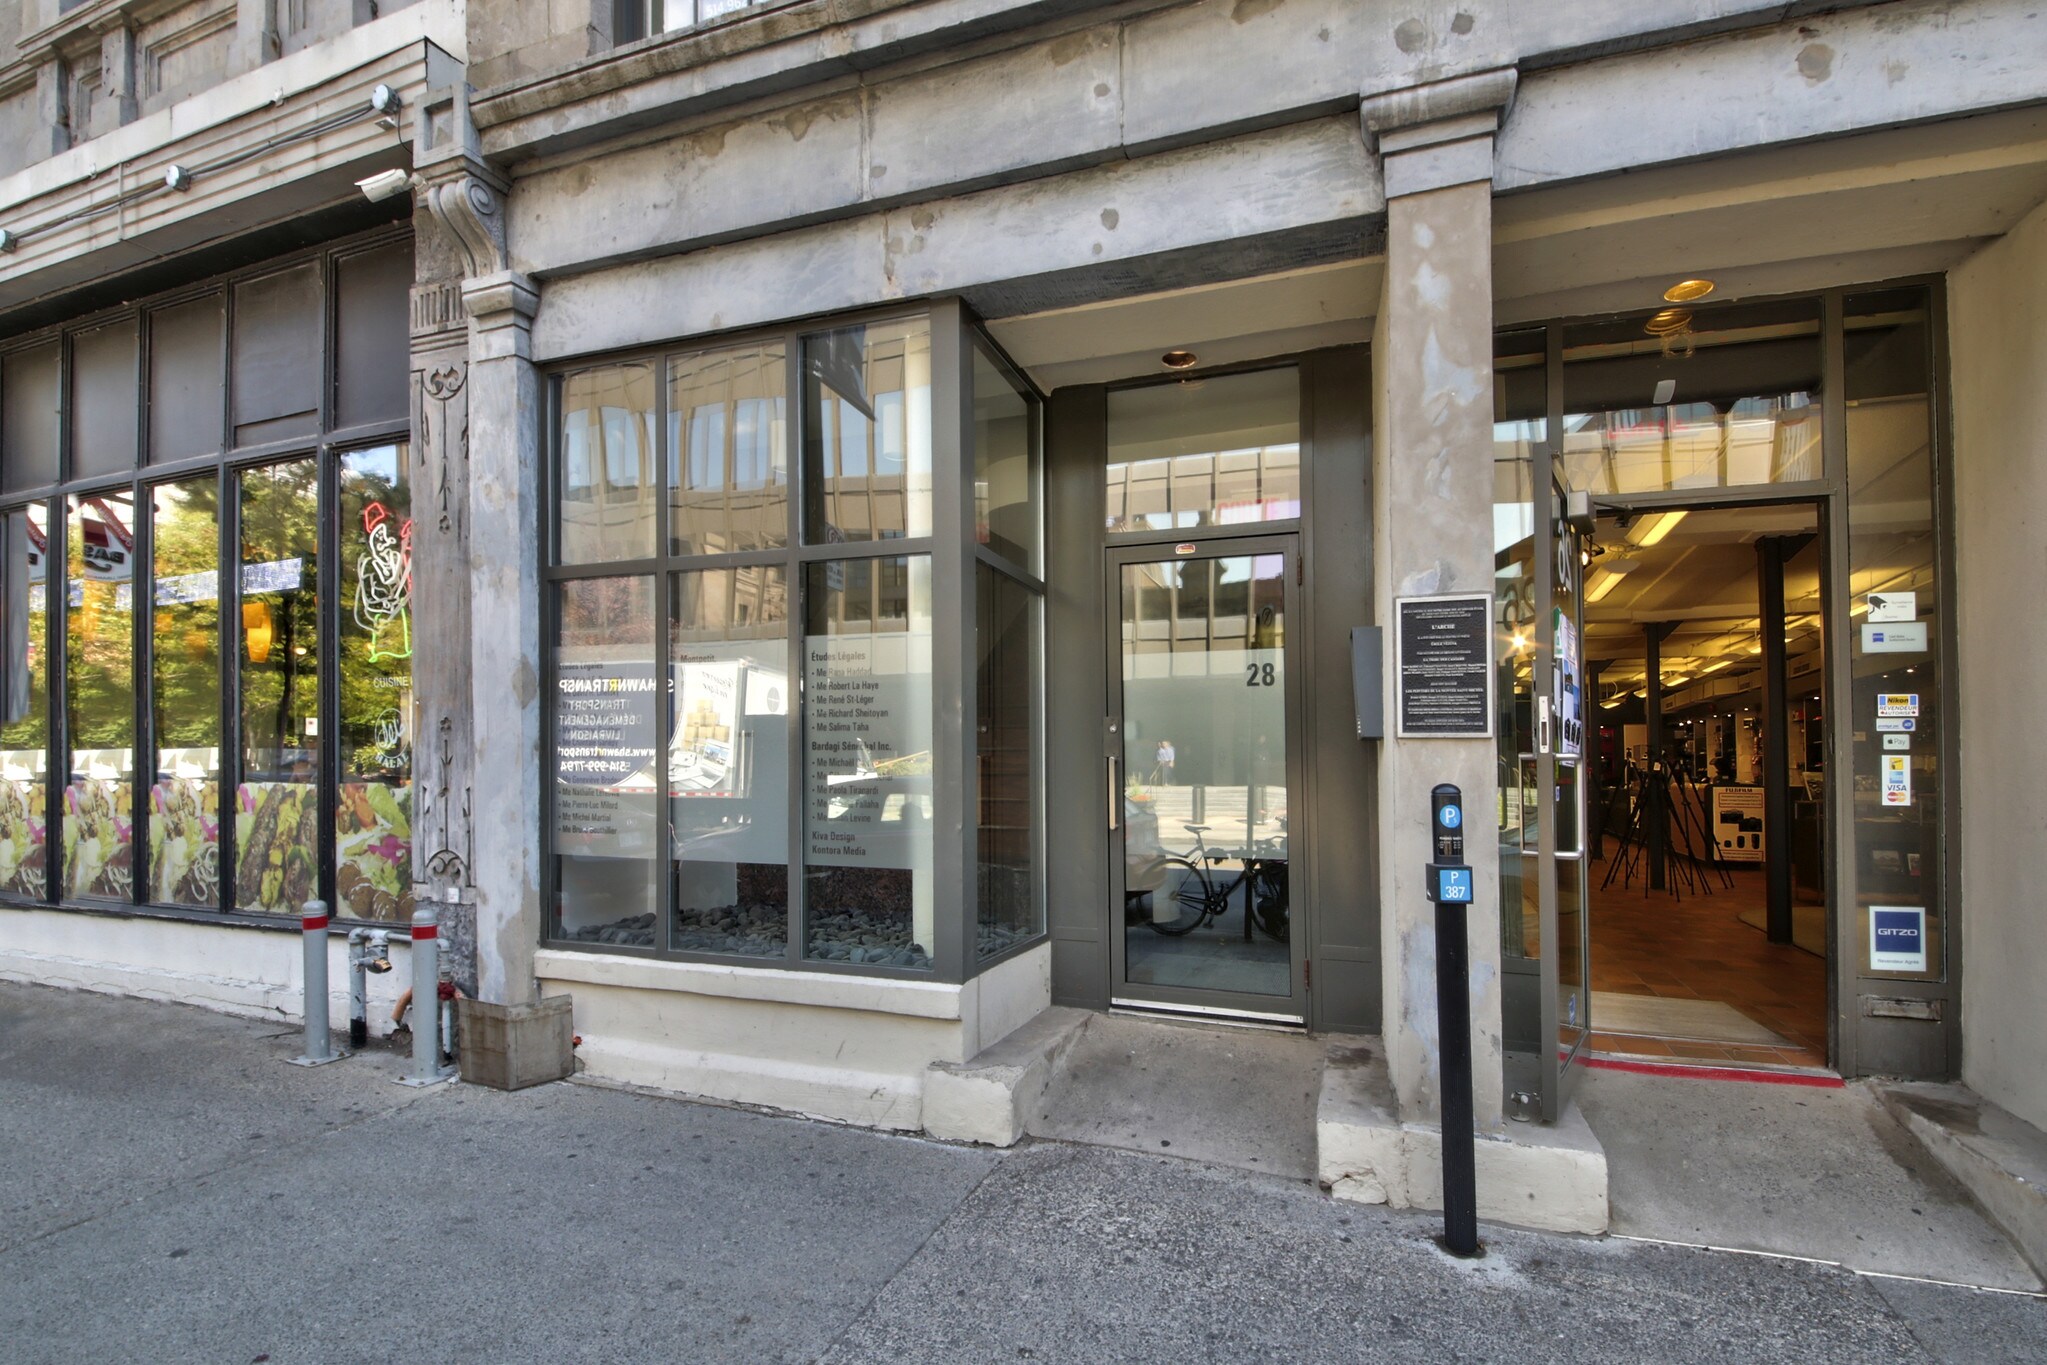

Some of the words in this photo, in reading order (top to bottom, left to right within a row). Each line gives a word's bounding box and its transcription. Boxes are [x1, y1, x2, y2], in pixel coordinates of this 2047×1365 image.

[811, 650, 836, 661] Études
[838, 651, 866, 662] Légales
[816, 668, 827, 677] Me
[1246, 662, 1275, 687] 28
[373, 676, 409, 688] CUISINE
[816, 682, 827, 690] Me
[829, 681, 850, 690] Robert
[852, 681, 860, 690] La
[862, 681, 879, 691] Haye
[816, 695, 827, 704] Me
[829, 695, 845, 704] René
[816, 709, 827, 718] Me
[829, 708, 853, 718] Richard
[816, 723, 827, 731] Me
[852, 722, 869, 731] Taha
[812, 741, 840, 752] Bardagi
[877, 742, 892, 751] Inc.
[1894, 738, 1906, 746] Pay
[817, 758, 827, 767] Me
[562, 787, 571, 796] Me
[817, 785, 827, 794] Me
[562, 800, 571, 808] Me
[817, 799, 827, 808] Me
[562, 825, 571, 833] Me
[812, 831, 828, 841] Kiva
[831, 831, 855, 843] Design
[812, 844, 841, 855] Kontora
[843, 844, 866, 856] Media
[1450, 871, 1459, 884] P
[1445, 885, 1466, 899] 387
[1877, 928, 1918, 936] GITZO
